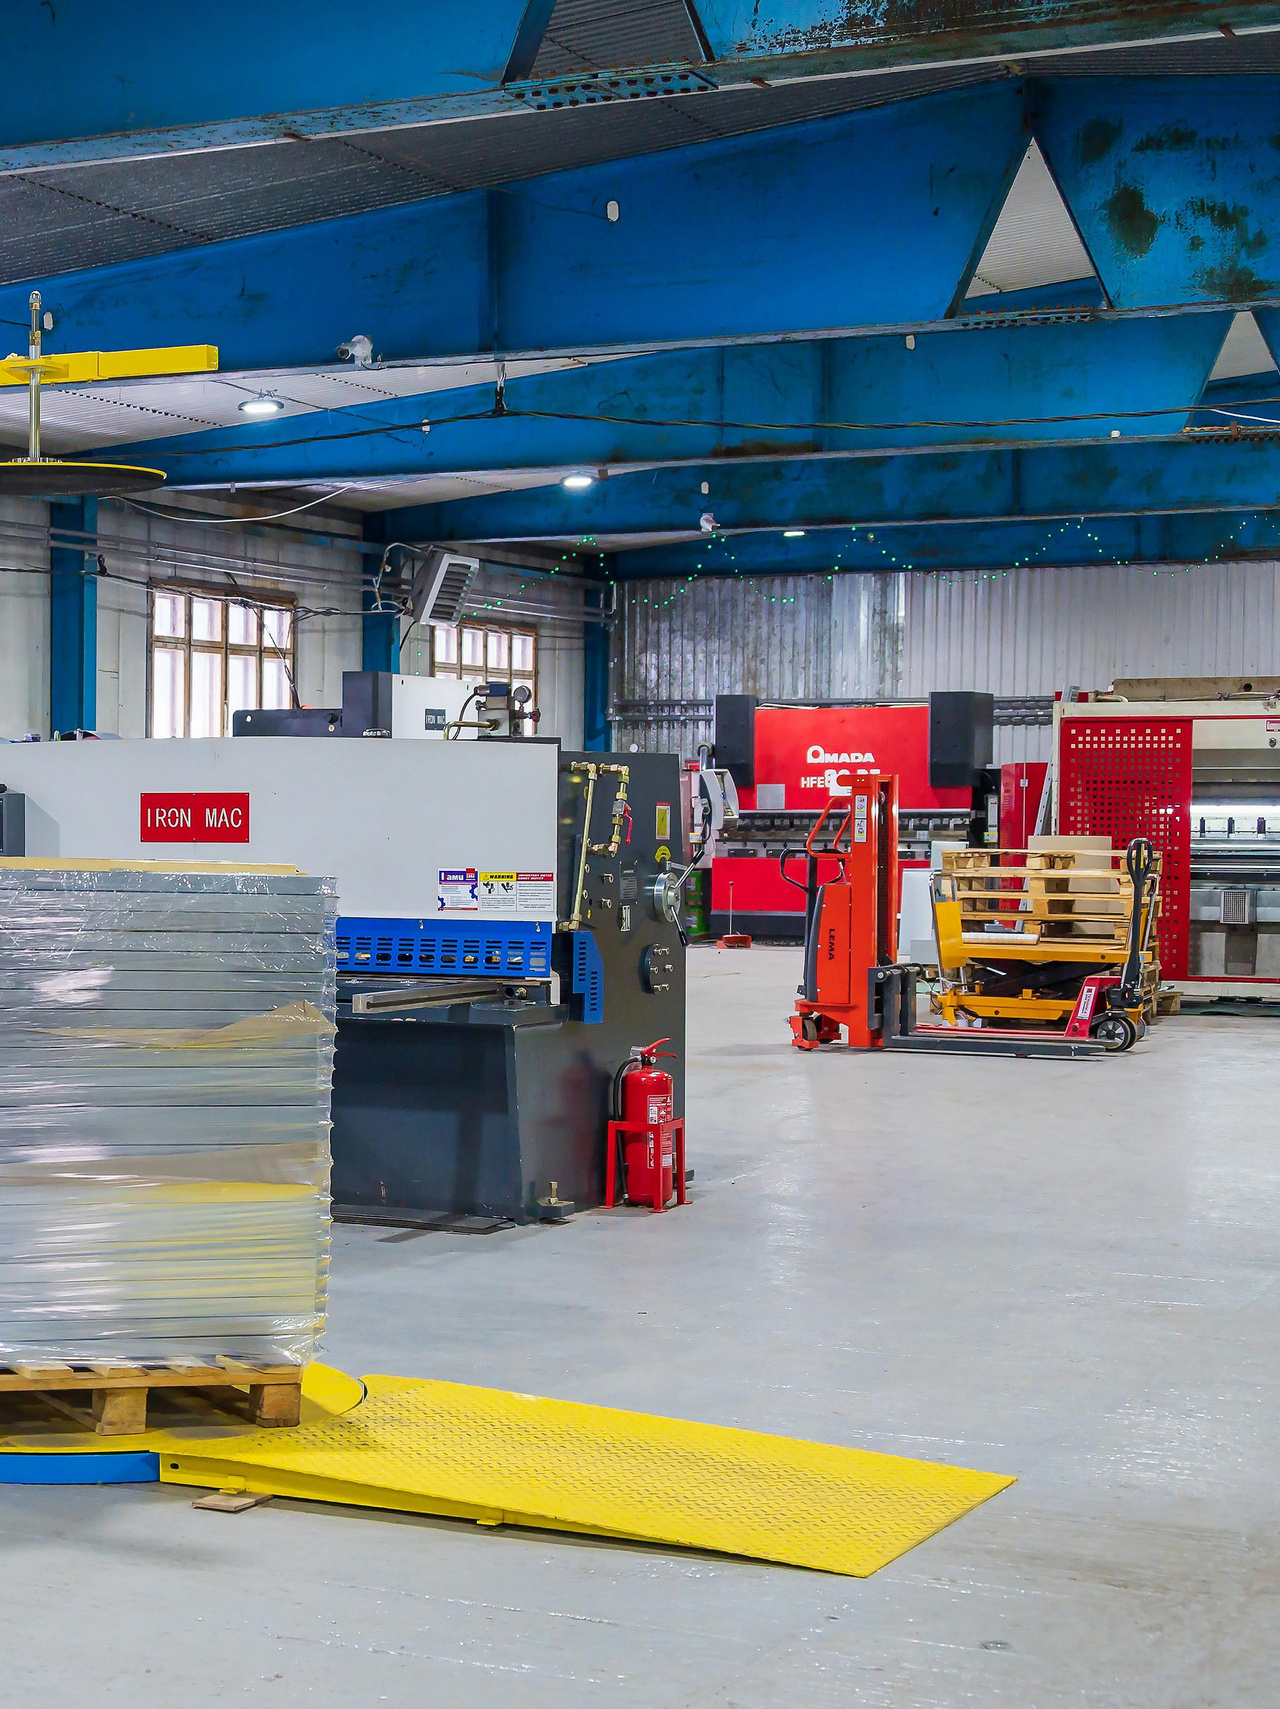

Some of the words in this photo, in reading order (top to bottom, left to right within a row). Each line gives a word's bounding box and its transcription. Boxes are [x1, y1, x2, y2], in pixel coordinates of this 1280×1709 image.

[807, 745, 875, 764] AMADA
[147, 808, 191, 828] IRON
[205, 808, 242, 828] MAC
